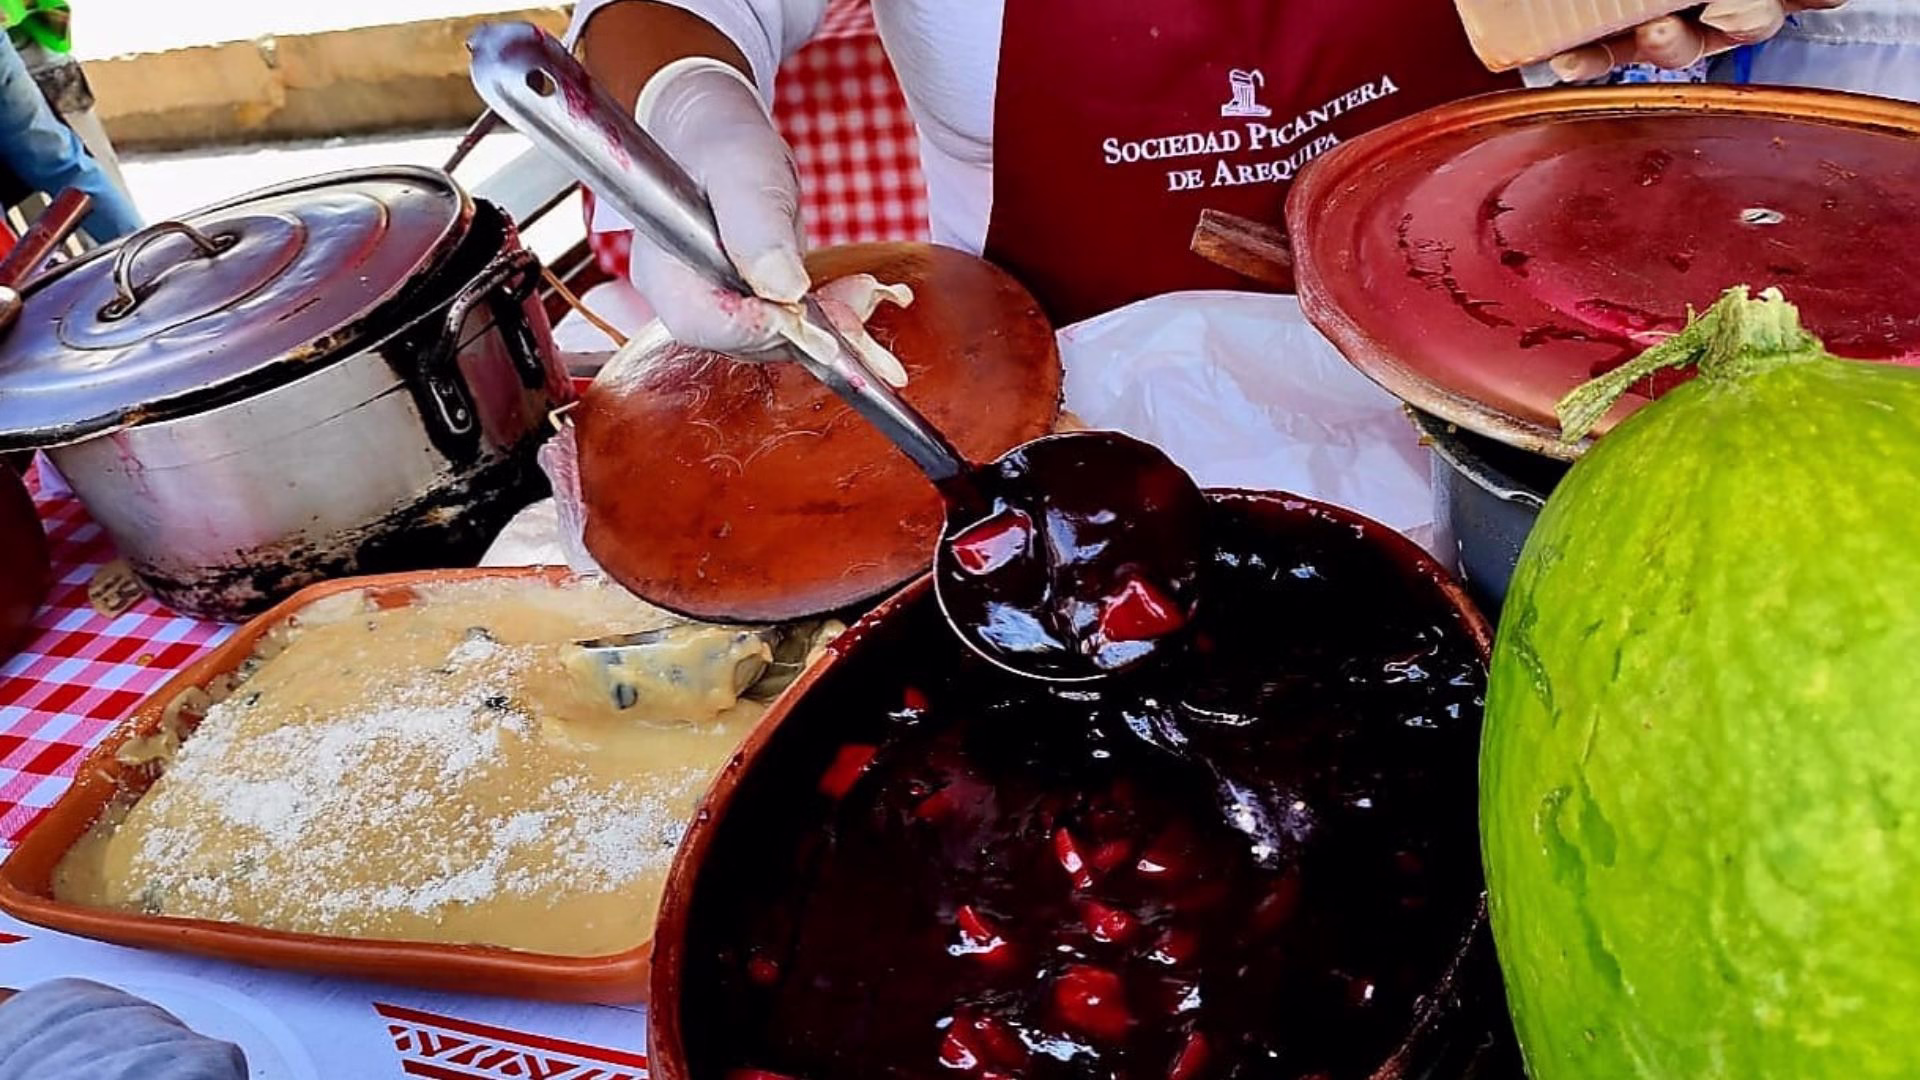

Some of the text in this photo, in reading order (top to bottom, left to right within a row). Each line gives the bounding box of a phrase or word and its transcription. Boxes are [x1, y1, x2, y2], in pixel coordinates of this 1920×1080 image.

[1102, 74, 1400, 164] SOCIEDAD PICANTERA
[1166, 132, 1341, 191] DE AREQUIPA
